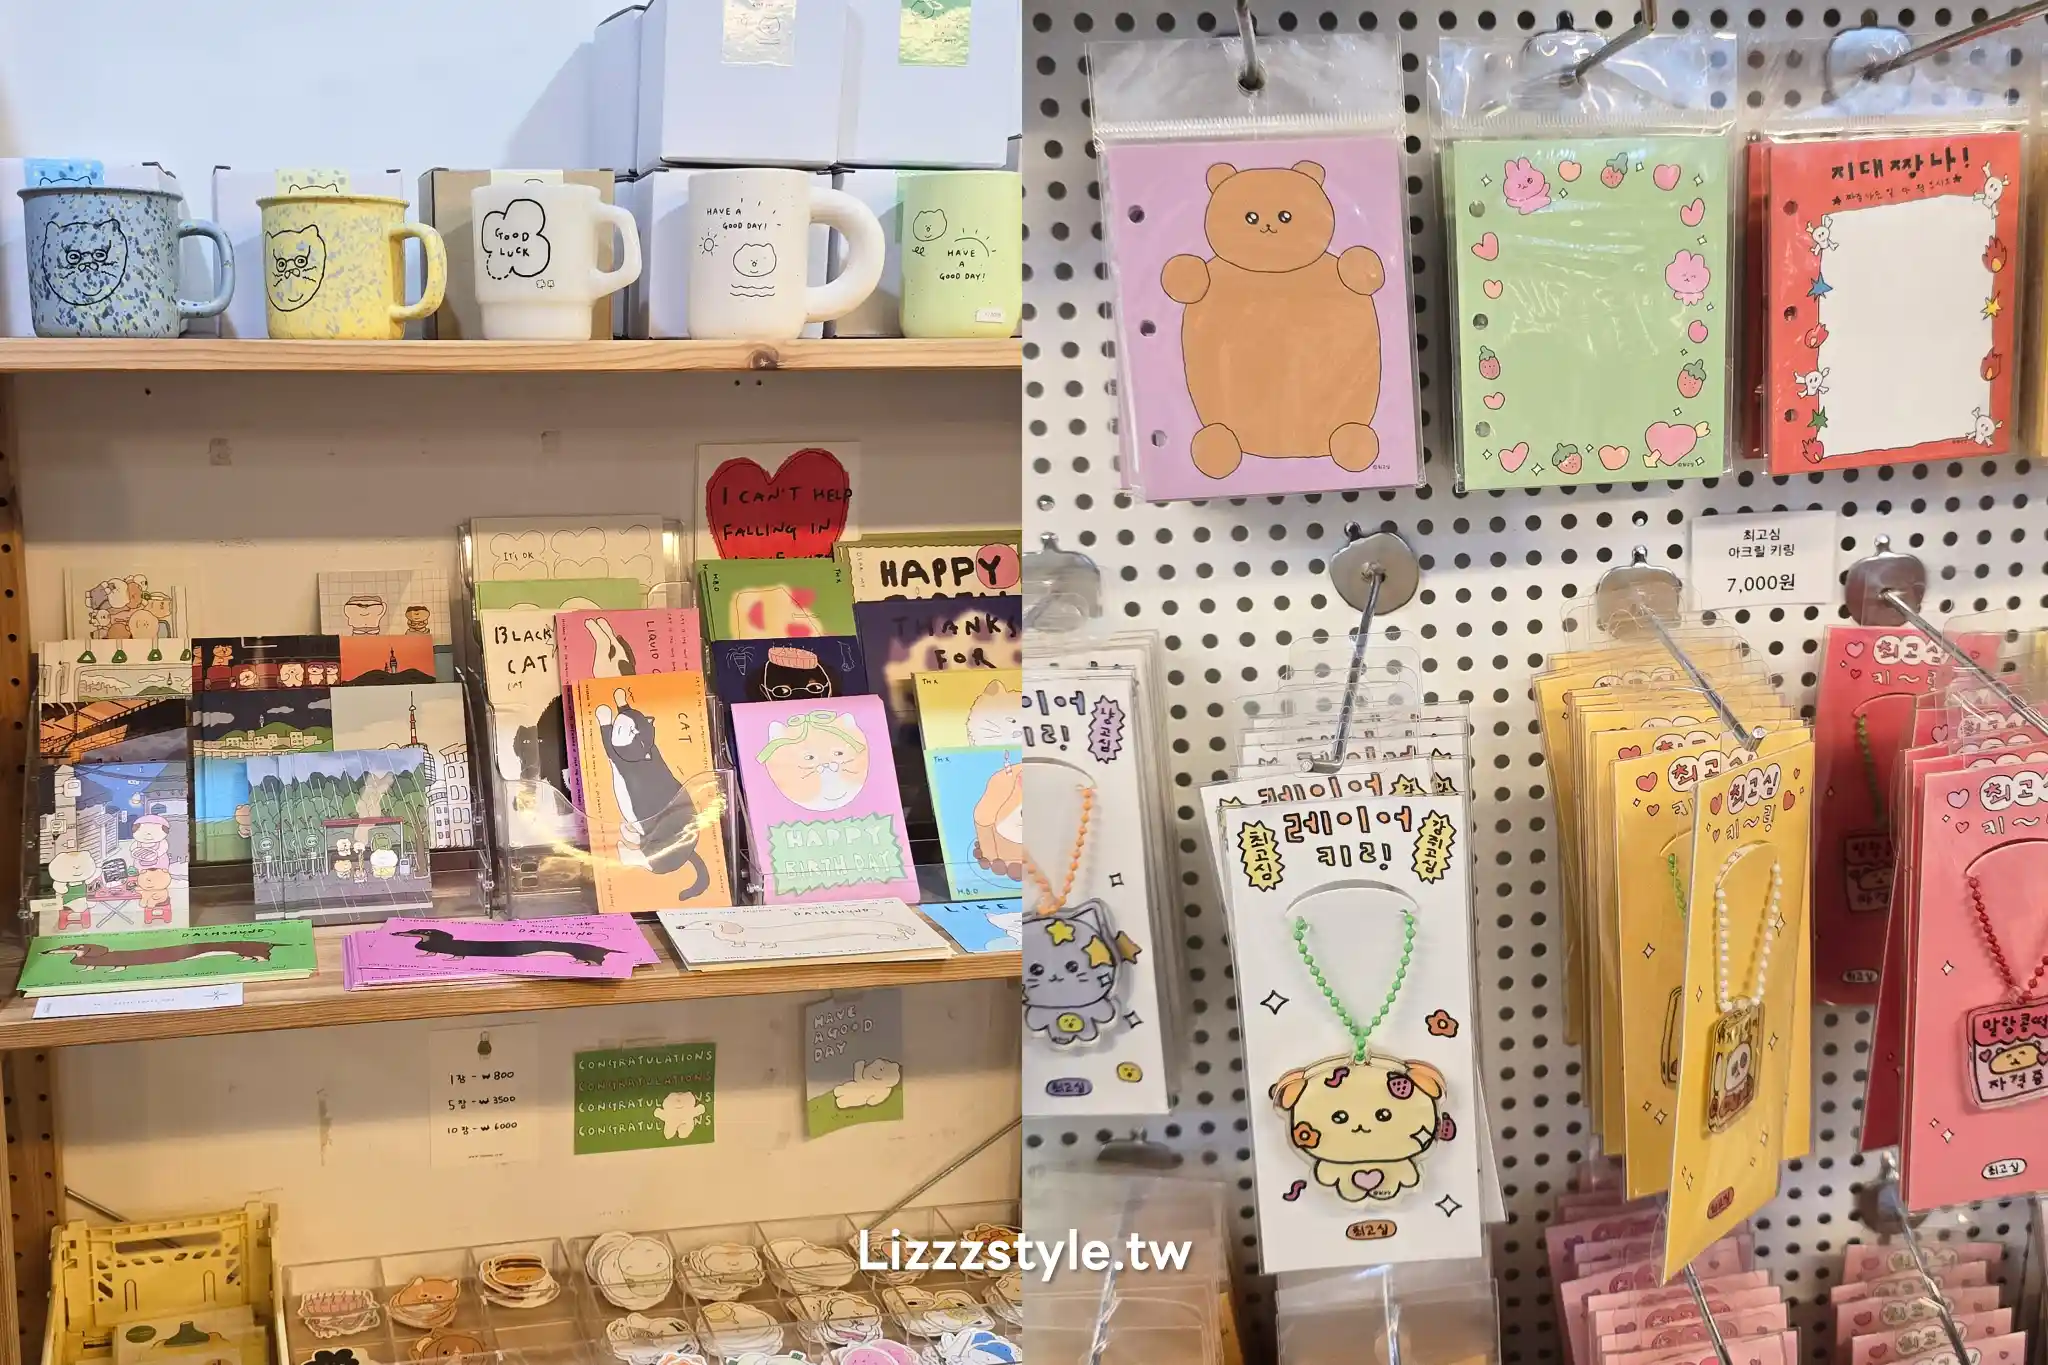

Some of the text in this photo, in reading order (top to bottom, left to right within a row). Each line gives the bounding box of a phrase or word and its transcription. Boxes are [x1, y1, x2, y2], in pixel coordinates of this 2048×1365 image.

[706, 207, 742, 217] HAVE A
[494, 227, 530, 242] GOOD
[722, 222, 768, 231] GOOD DAY!
[499, 245, 531, 258] LUCK
[947, 248, 976, 259] HAVE
[939, 272, 987, 283] GOOD DAY!
[722, 486, 853, 505] I CAN'T HELP
[723, 519, 831, 540] FALLING IN
[1743, 528, 1781, 541] 최고심
[522, 551, 535, 560] OK
[1728, 543, 1795, 558] 아크릴 키링
[879, 554, 1002, 588] HAPPY
[1727, 573, 1795, 594] 7,000원
[494, 625, 552, 644] BLACK
[892, 612, 1017, 638] THANKS
[646, 620, 660, 660] LIQUID
[507, 653, 549, 675] CAT
[934, 647, 997, 670] FOR
[677, 712, 692, 744] CAT
[1729, 771, 1779, 808] 최고심
[1983, 778, 2048, 805] 최고
[1283, 804, 1412, 844] 레이어
[784, 824, 881, 849] HAPPY
[1249, 831, 1273, 882] 최고심
[944, 903, 1009, 914] LIKE
[813, 1004, 857, 1029] HAVE
[578, 1050, 713, 1070] CONGRATULATIONS
[813, 1040, 848, 1062] DAY
[578, 1071, 713, 1092] CONGRATULATIONS
[1988, 1069, 2044, 1091] 자격증
[578, 1115, 712, 1137] CONGRATULNS
[1987, 1161, 2020, 1176] 최고심
[1351, 1222, 1391, 1238] 최고심
